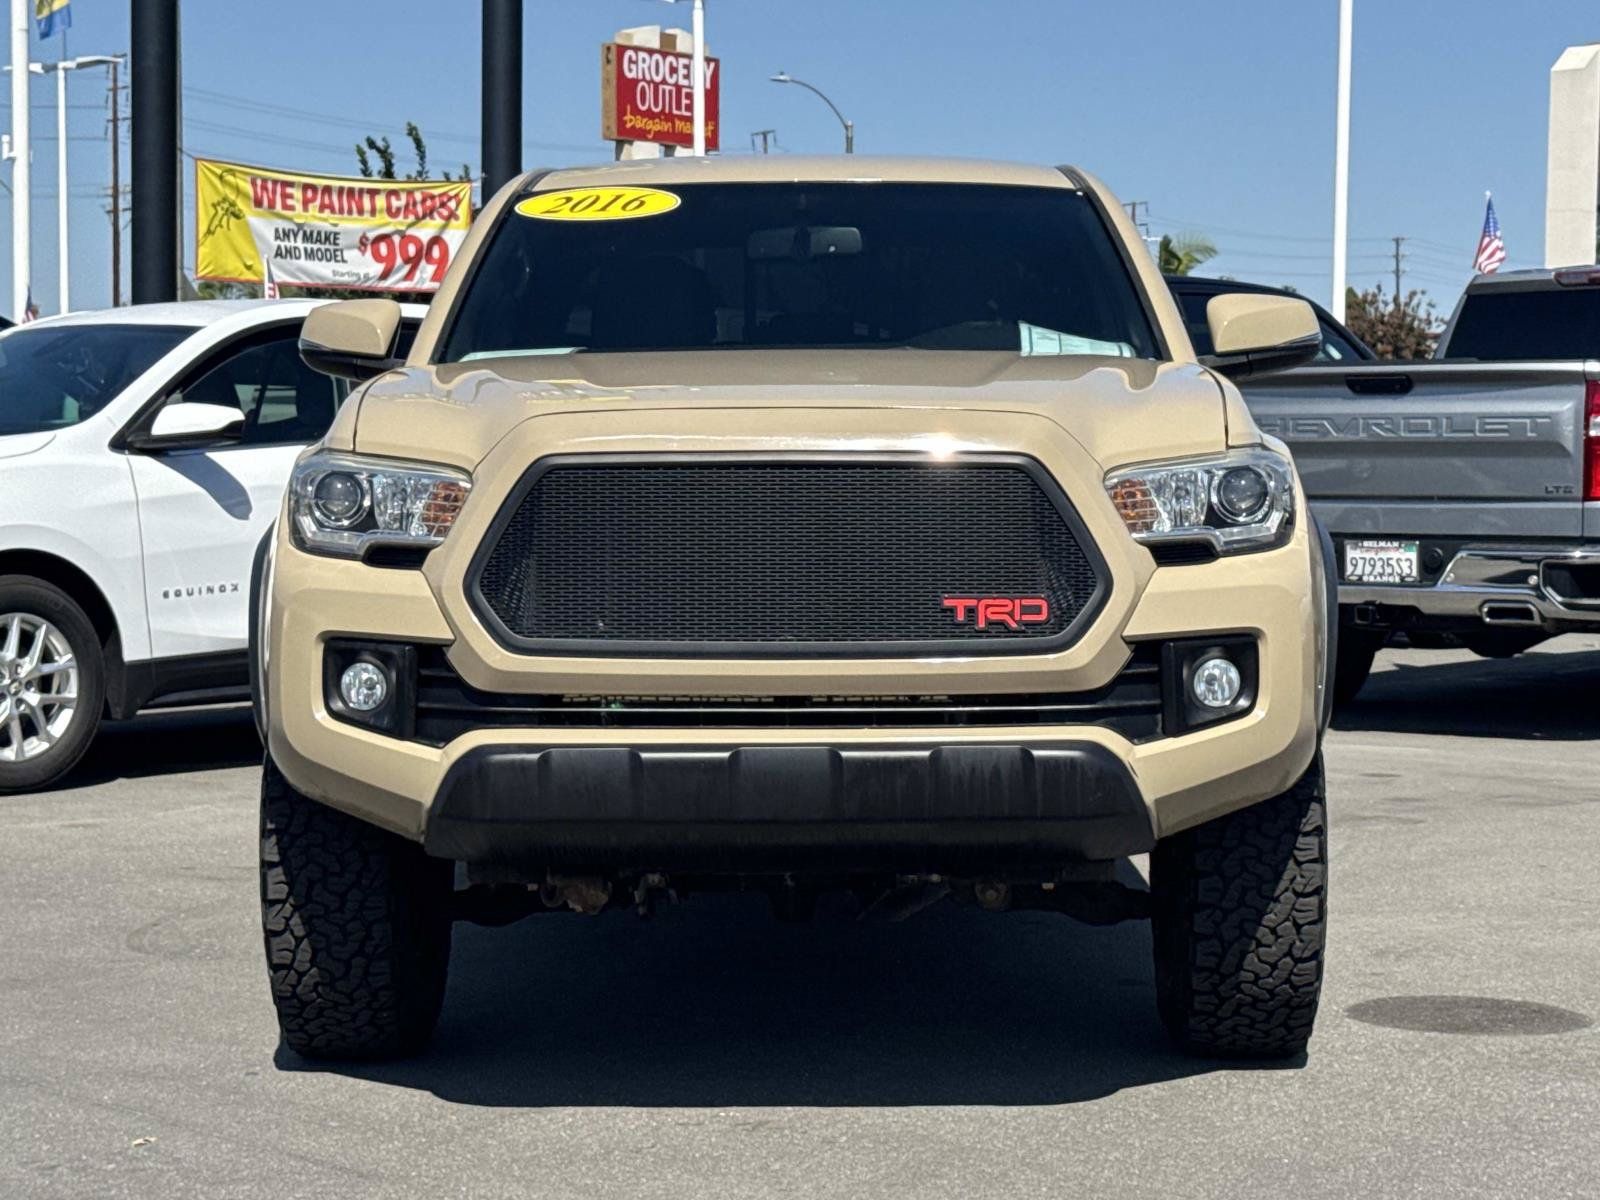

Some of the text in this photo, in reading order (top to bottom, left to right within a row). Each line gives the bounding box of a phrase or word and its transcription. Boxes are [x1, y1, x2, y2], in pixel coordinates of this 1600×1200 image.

[636, 81, 693, 116] OUTLE
[623, 104, 672, 138] bargain
[250, 176, 460, 221] WE PAINT CARS!
[541, 193, 656, 214] 2016
[274, 227, 341, 246] ANY MAKE
[274, 244, 348, 264] AND MODEL
[358, 231, 450, 283] $999
[1254, 416, 1551, 438] HEVROLET
[162, 583, 239, 599] EQUINOX
[943, 598, 1049, 629] TRD
